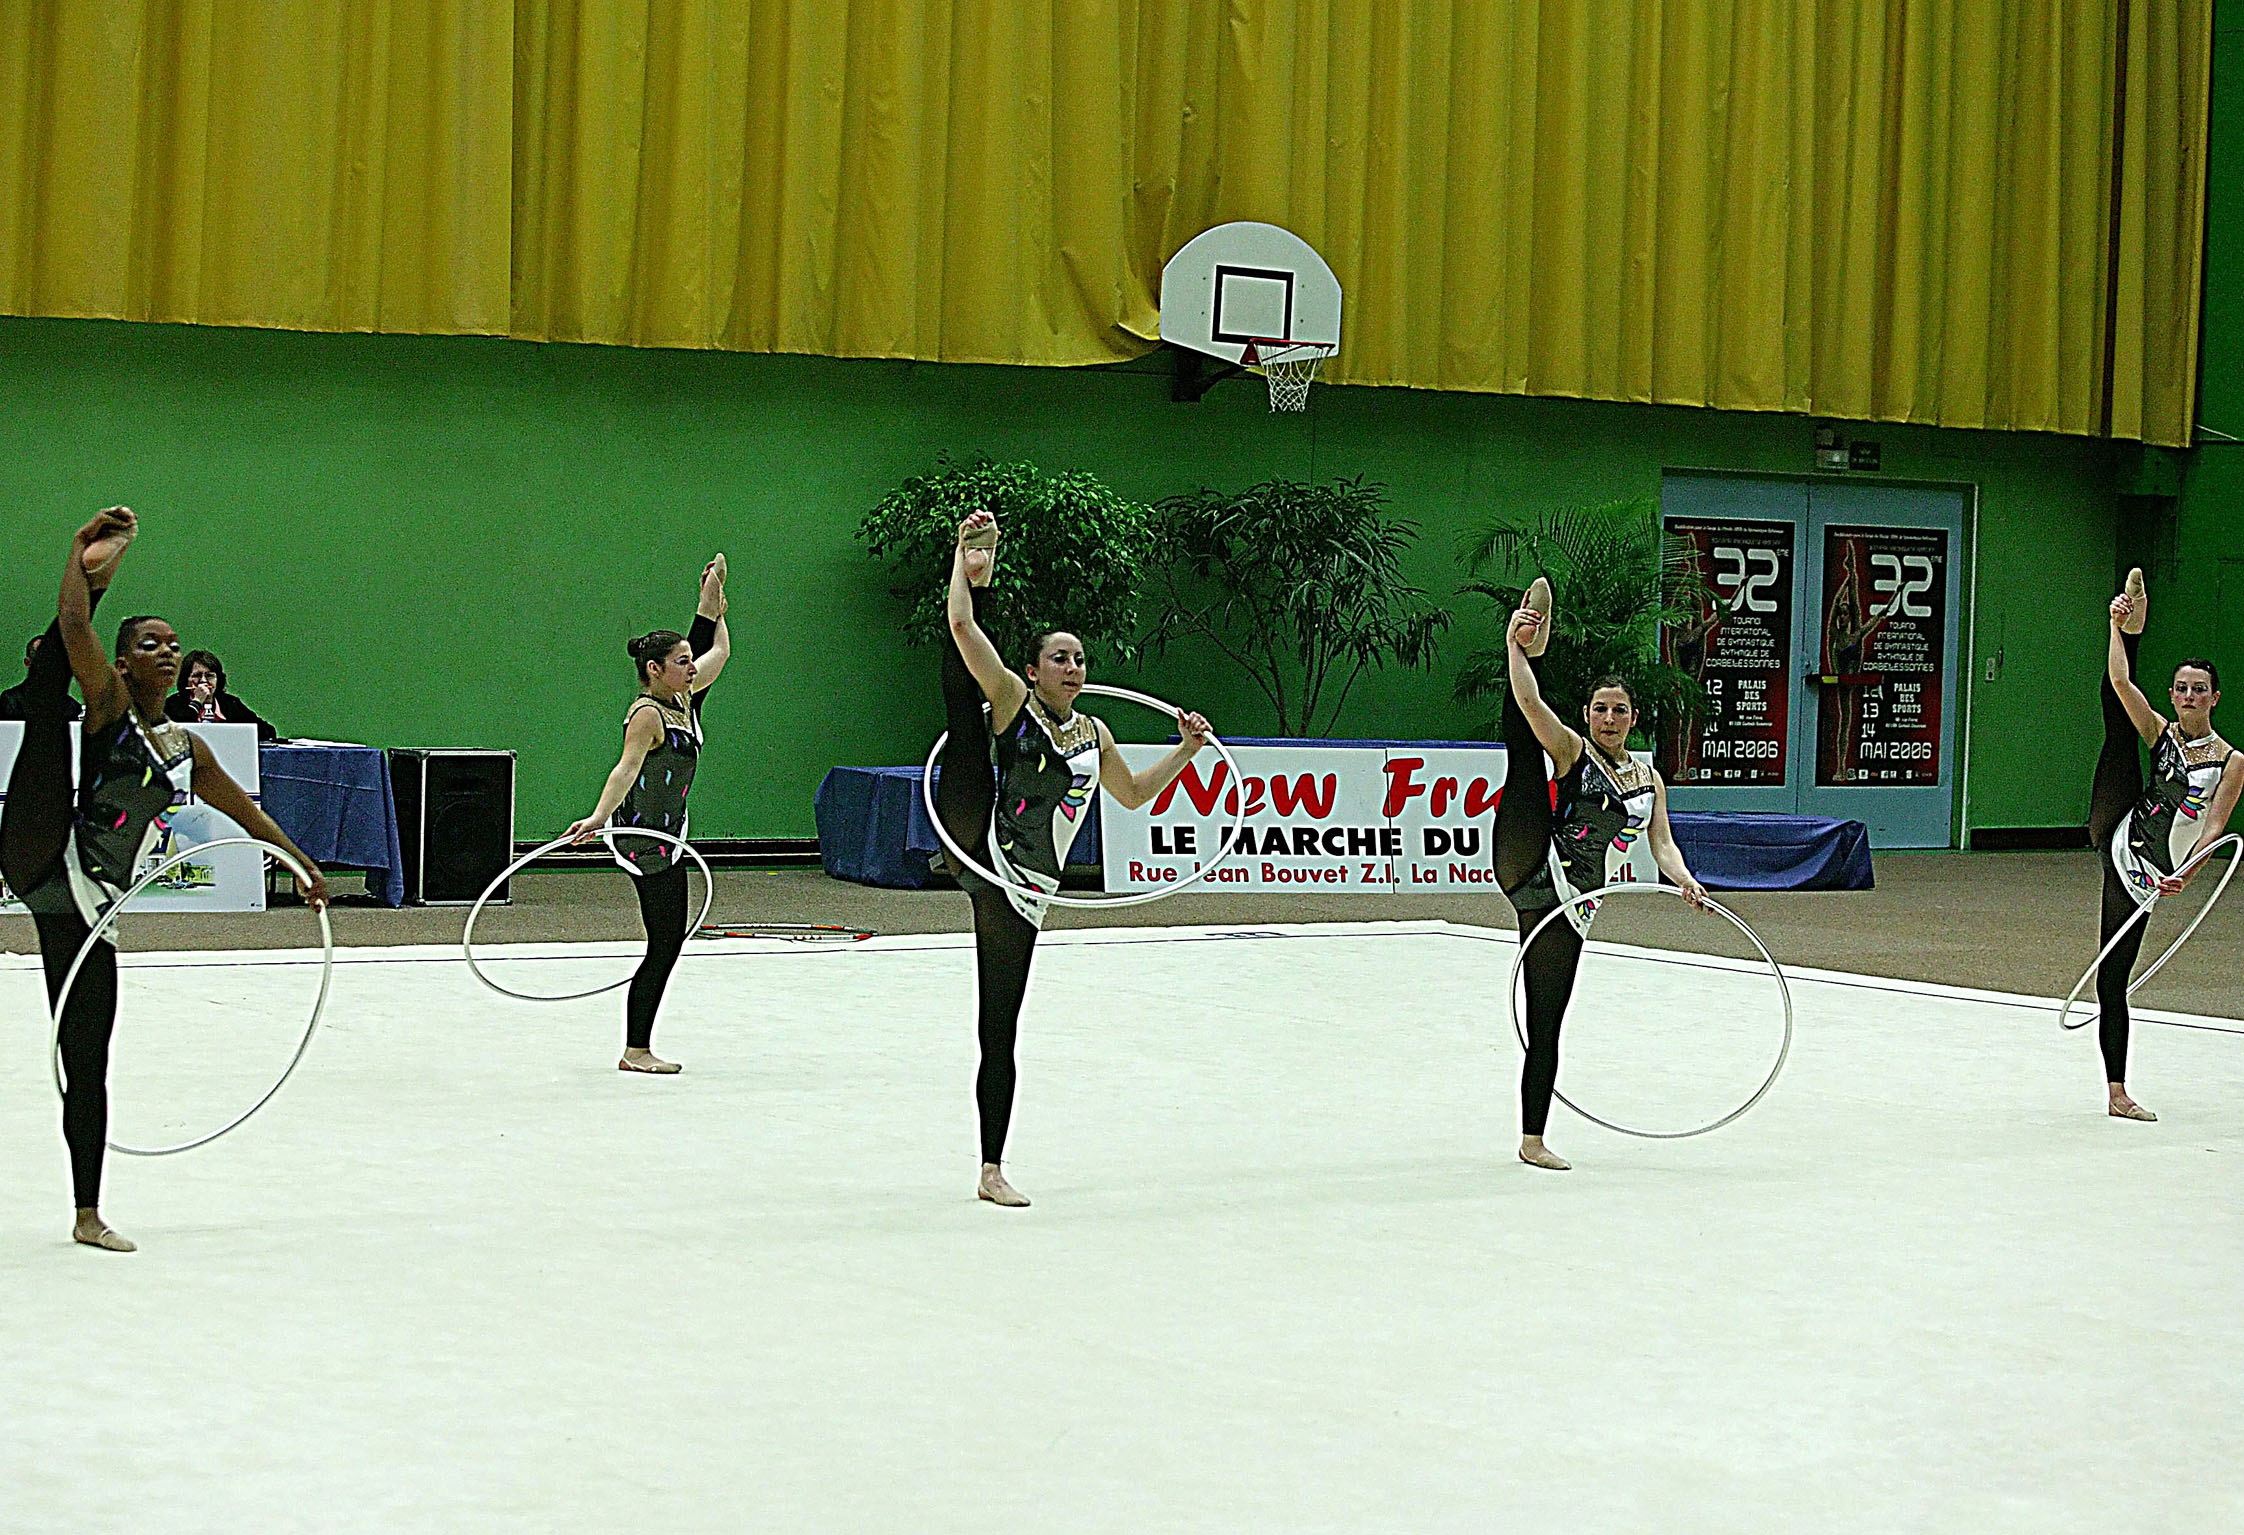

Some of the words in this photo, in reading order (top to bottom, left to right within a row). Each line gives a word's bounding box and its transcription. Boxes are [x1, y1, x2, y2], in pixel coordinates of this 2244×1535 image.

[1713, 547, 1779, 612] 32
[1869, 554, 1933, 617] 32
[1717, 638, 1726, 646] DE
[1873, 642, 1883, 650] DE
[1760, 649, 1770, 658] DE
[1915, 653, 1925, 661] DE
[1706, 679, 1723, 695] 12
[1737, 679, 1767, 690] PALAIS
[1893, 682, 1921, 693] PALAIS
[1744, 690, 1760, 700] DES
[1899, 693, 1915, 703] DES
[1736, 701, 1767, 711] SPORTS
[1862, 702, 1879, 718] 13
[1892, 703, 1922, 714] SPORTS
[1860, 722, 1876, 738] 14
[1702, 740, 1731, 759] MAI
[1734, 740, 1779, 759] 2006
[1860, 741, 1887, 759] MAI
[1889, 741, 1932, 759] 2006
[1150, 759, 1337, 820] New
[1382, 757, 1506, 818] Fru
[1150, 826, 1197, 855] LE
[1219, 826, 1403, 857] MARCHE
[1423, 828, 1480, 857] DU
[1129, 861, 1178, 882] Rue
[1261, 862, 1349, 884] Bouvet
[1360, 863, 1401, 884] Z.I.
[1411, 863, 1438, 884] La
[1449, 863, 1494, 884] Nac
